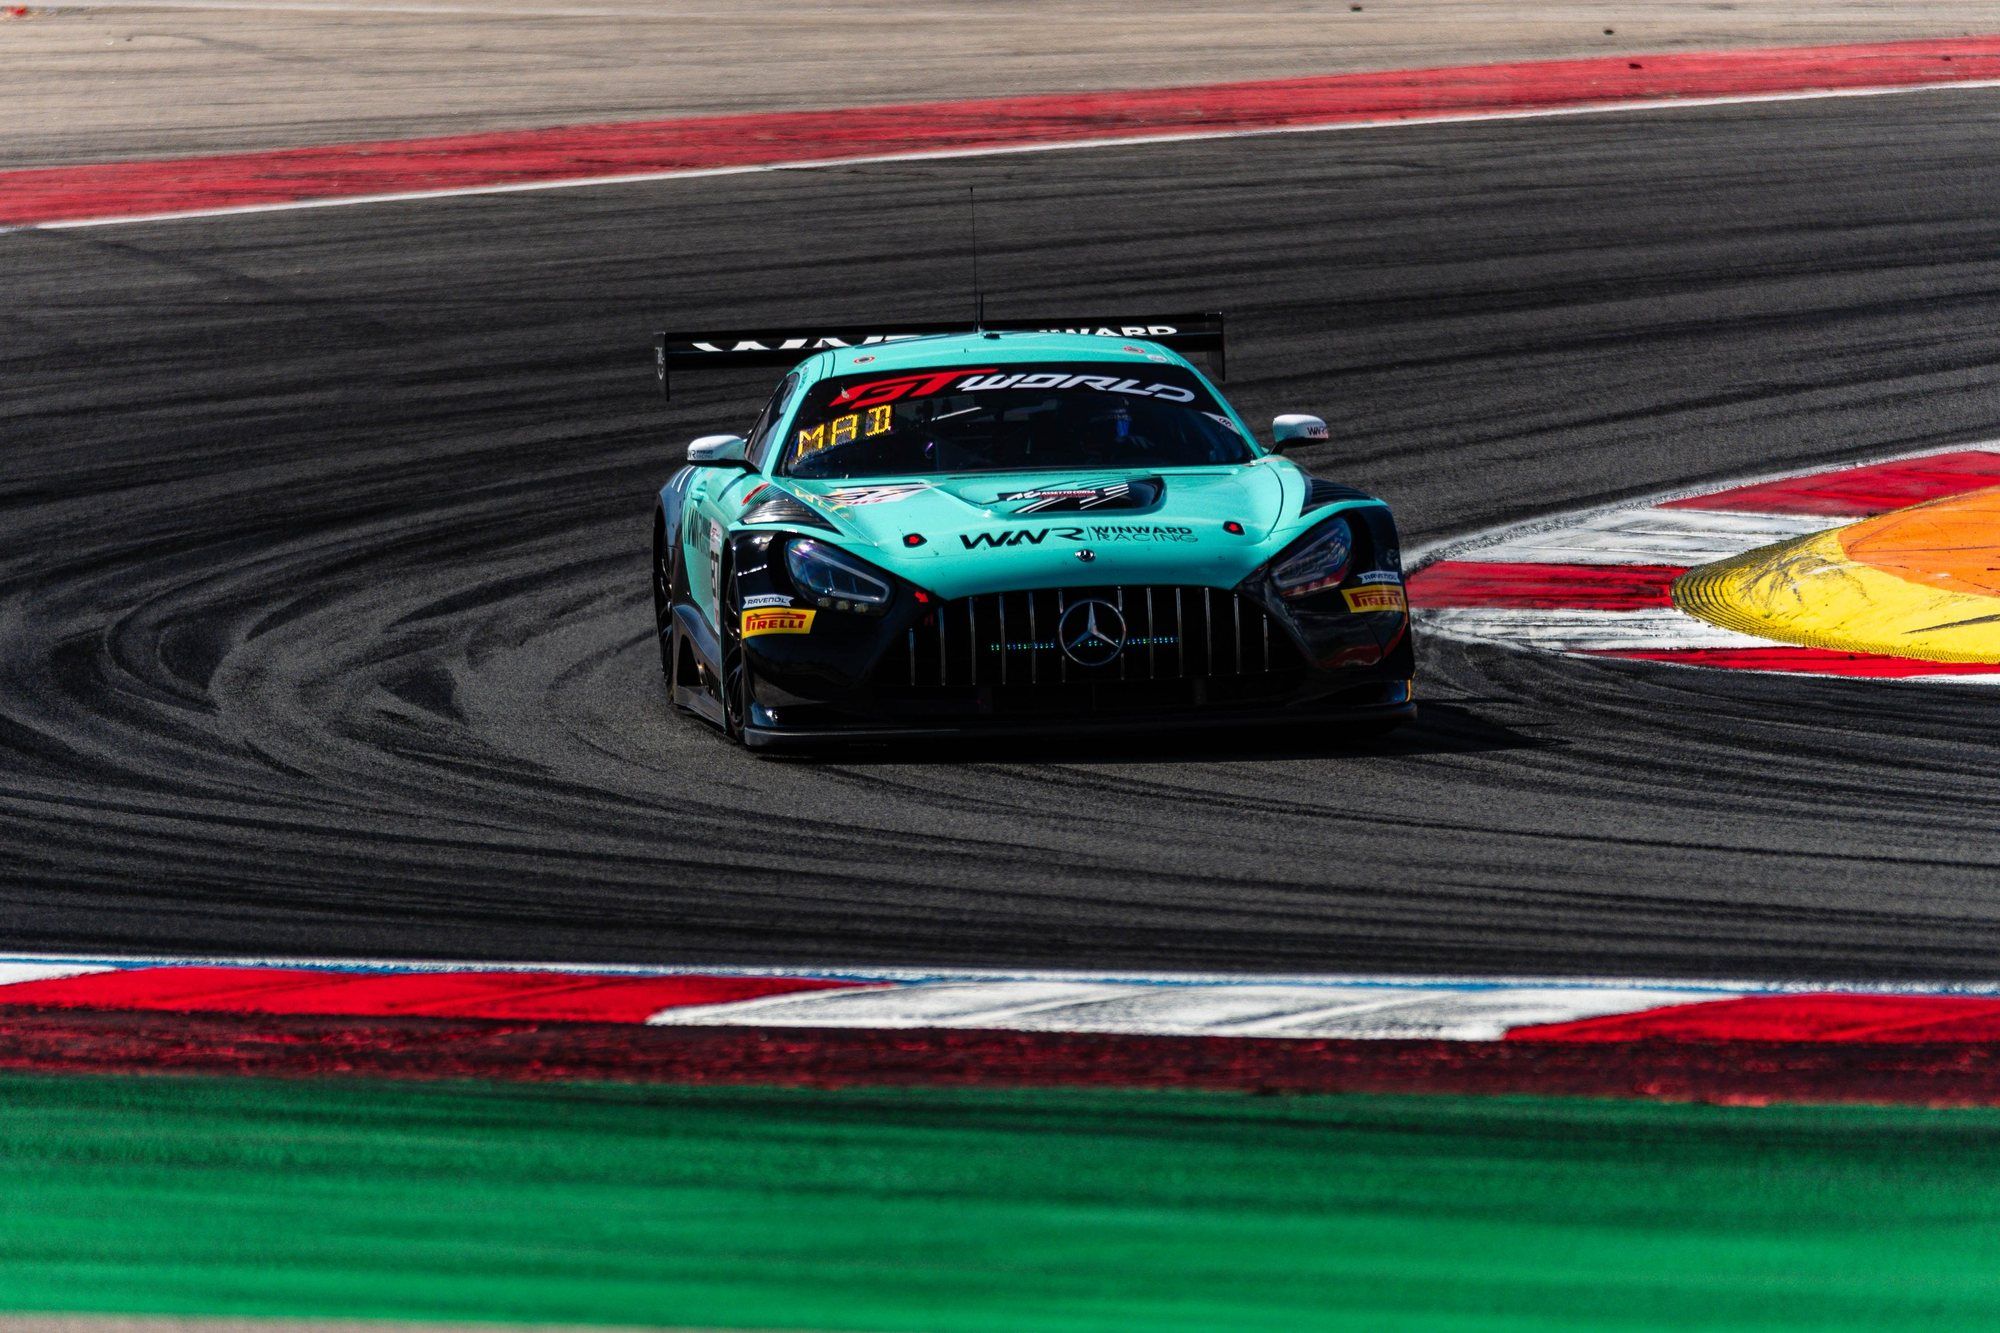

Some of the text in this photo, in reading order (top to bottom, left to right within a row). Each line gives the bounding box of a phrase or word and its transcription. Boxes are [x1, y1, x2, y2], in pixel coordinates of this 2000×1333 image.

[828, 368, 1196, 410] GT WORLD
[1091, 526, 1193, 536] WINWARD
[1096, 534, 1198, 543] RACING
[747, 596, 787, 606] RAVENOL
[745, 612, 807, 632] PIRELLI
